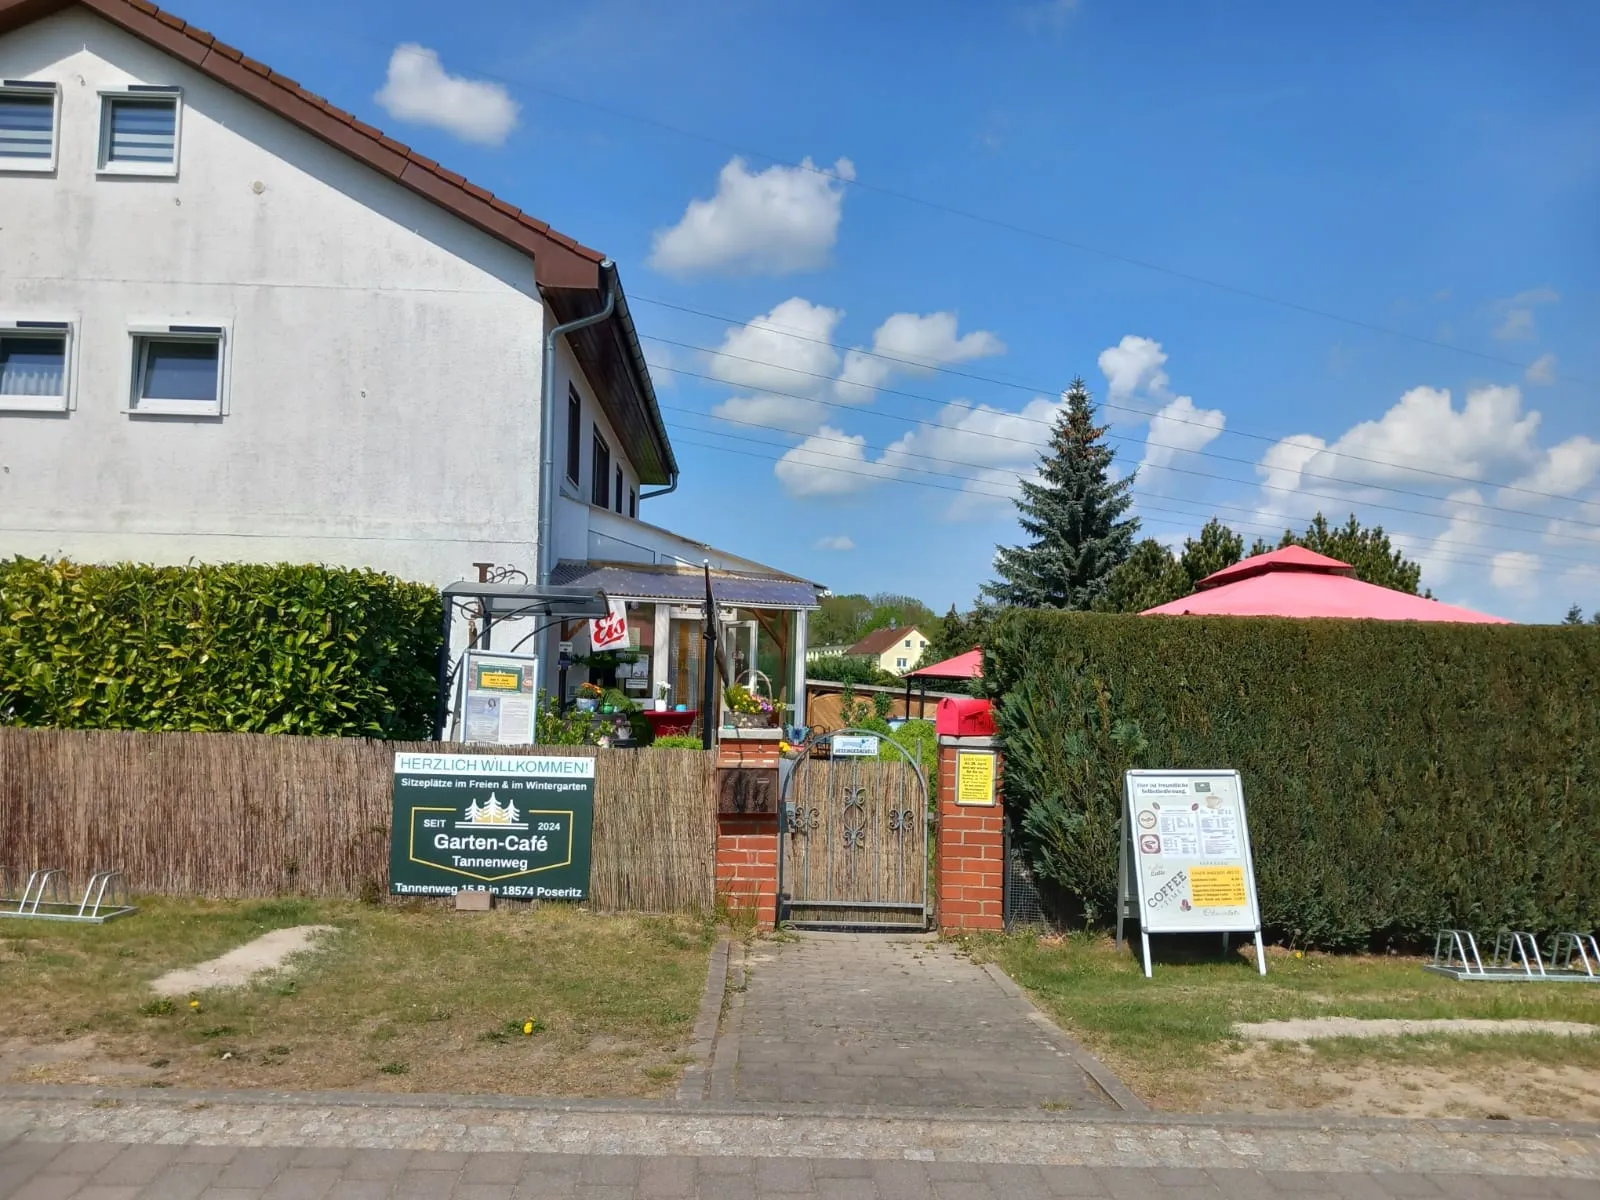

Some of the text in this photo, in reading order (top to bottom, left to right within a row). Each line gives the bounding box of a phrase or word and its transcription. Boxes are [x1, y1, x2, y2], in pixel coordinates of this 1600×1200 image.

[593, 611, 626, 644] Eis
[400, 757, 589, 774] HERZLICH WILLKOMMEN!
[401, 778, 587, 793] Sitzeplätze im Freien & im Wintergarten
[423, 819, 446, 828] SEIT
[538, 822, 561, 831] 2024
[434, 834, 549, 852] Garten-Café
[452, 855, 528, 871] Tannenweg
[395, 882, 458, 896] Tannenweg
[488, 885, 500, 895] in
[502, 886, 534, 896] 18574
[536, 887, 582, 898] Poseritz
[1147, 871, 1188, 908] COFFEE
